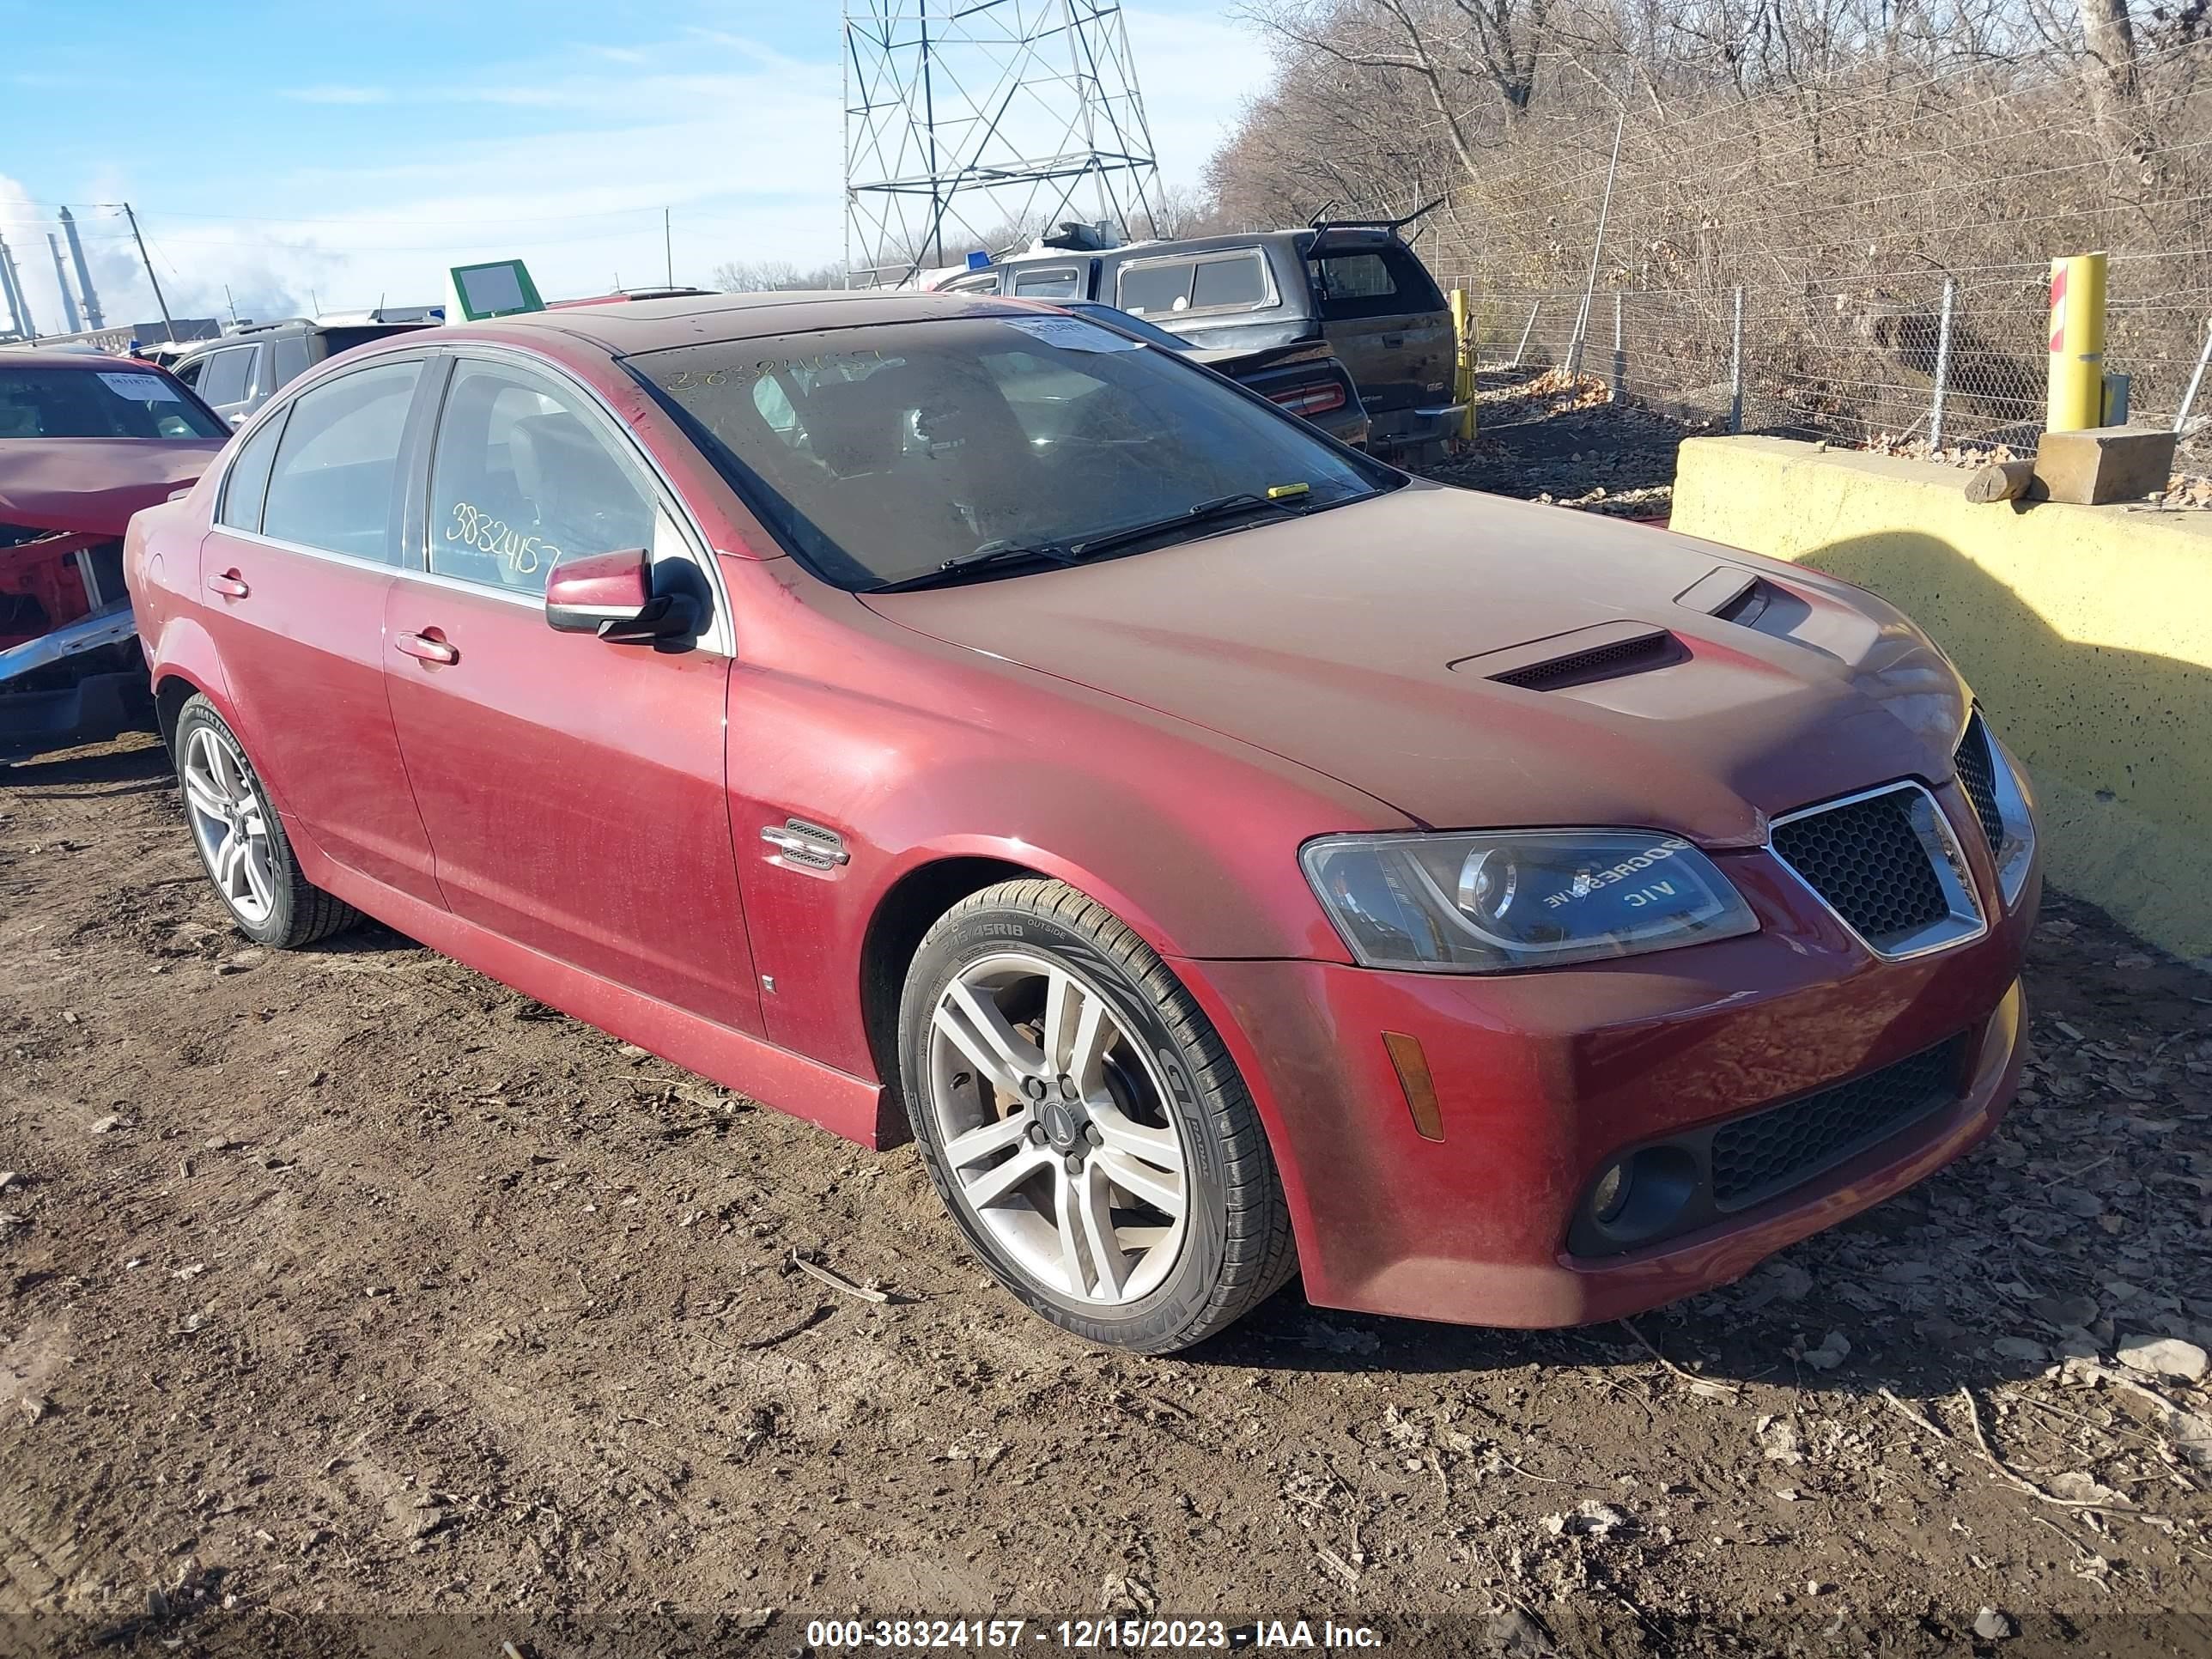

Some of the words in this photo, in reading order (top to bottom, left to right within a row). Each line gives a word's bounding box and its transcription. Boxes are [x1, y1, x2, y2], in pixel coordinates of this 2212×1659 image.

[446, 502, 562, 586] 38324157
[1028, 919, 1067, 940] OUTSIDE
[1191, 1120, 1209, 1181] RADIAL
